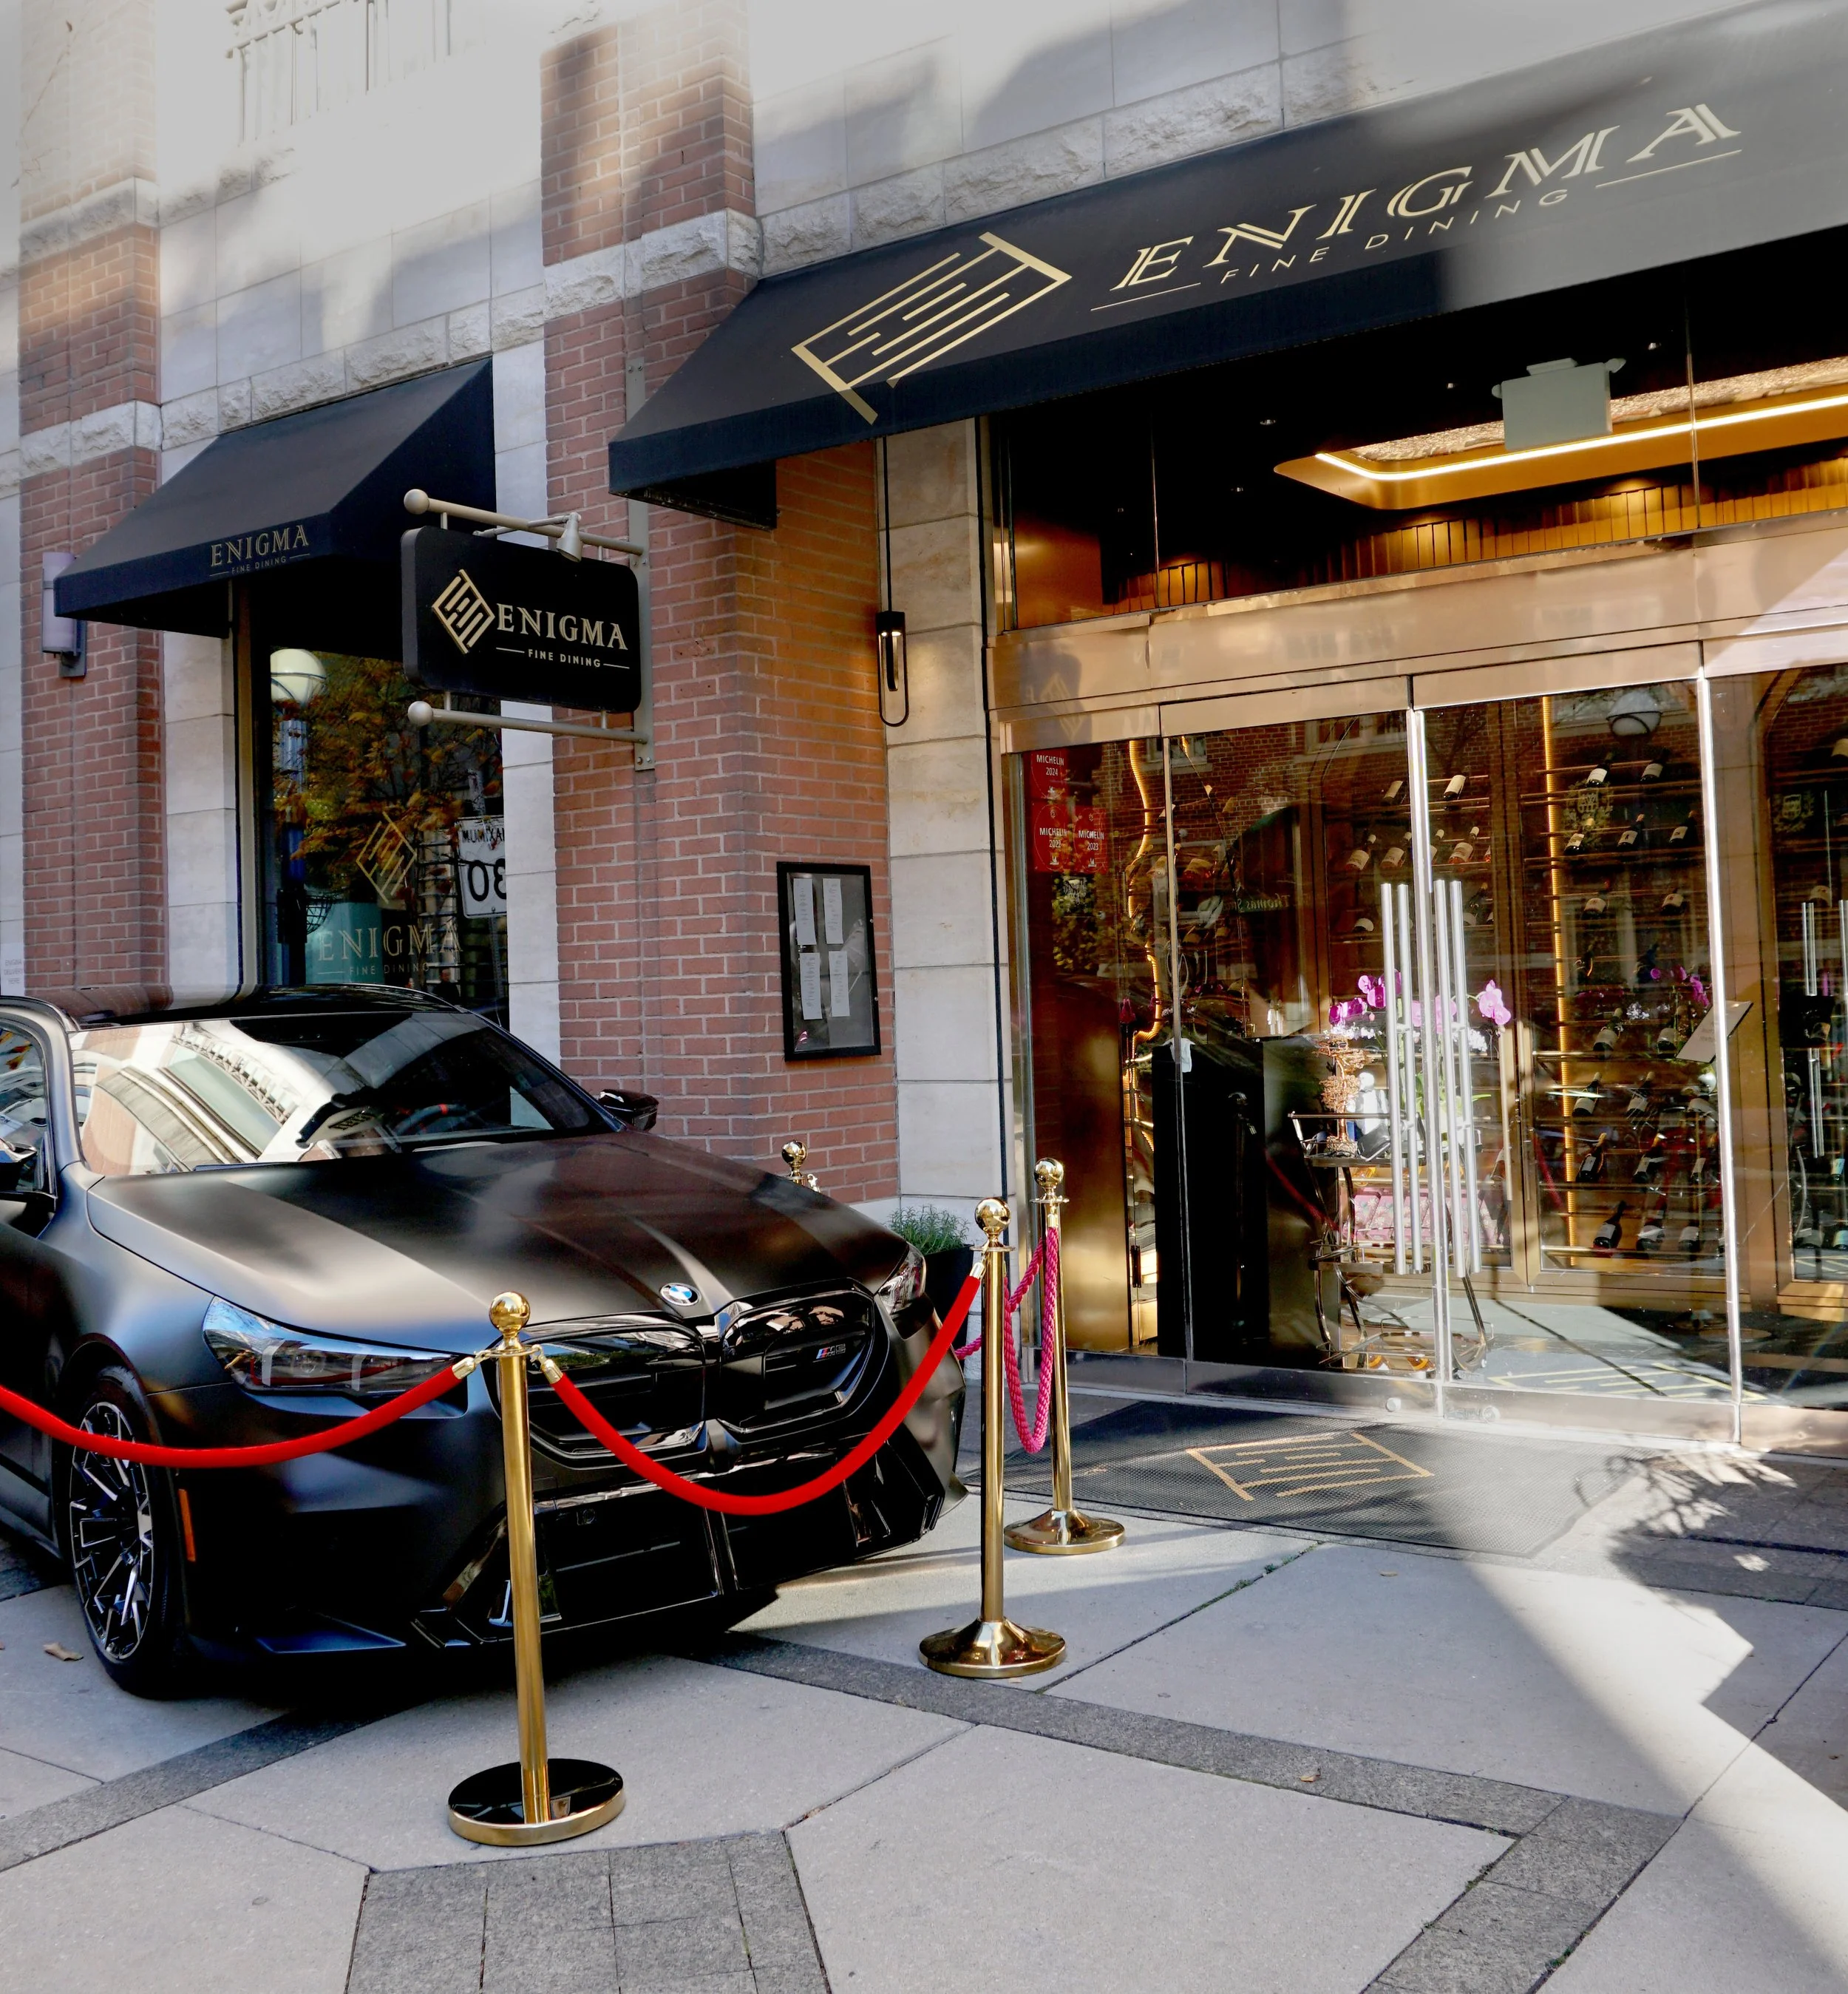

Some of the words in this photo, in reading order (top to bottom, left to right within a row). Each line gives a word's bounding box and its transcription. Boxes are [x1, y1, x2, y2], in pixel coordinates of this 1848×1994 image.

[1110, 103, 1742, 291] ENIGMA
[1220, 246, 1330, 284] FINE
[1365, 188, 1569, 251] DINING
[211, 524, 309, 567] ENIGMA
[231, 563, 251, 574] FINE
[255, 555, 287, 569] DINING
[496, 603, 628, 651] ENIGMA
[528, 648, 554, 661] FINE
[560, 654, 601, 668] DINING
[1036, 754, 1064, 766] MICHELIN
[1045, 767, 1059, 776] 2024
[1039, 827, 1067, 837] MICHELIN
[1078, 830, 1104, 840] MICHELIN
[319, 923, 463, 961] ENIGMA
[350, 965, 376, 977] FINE
